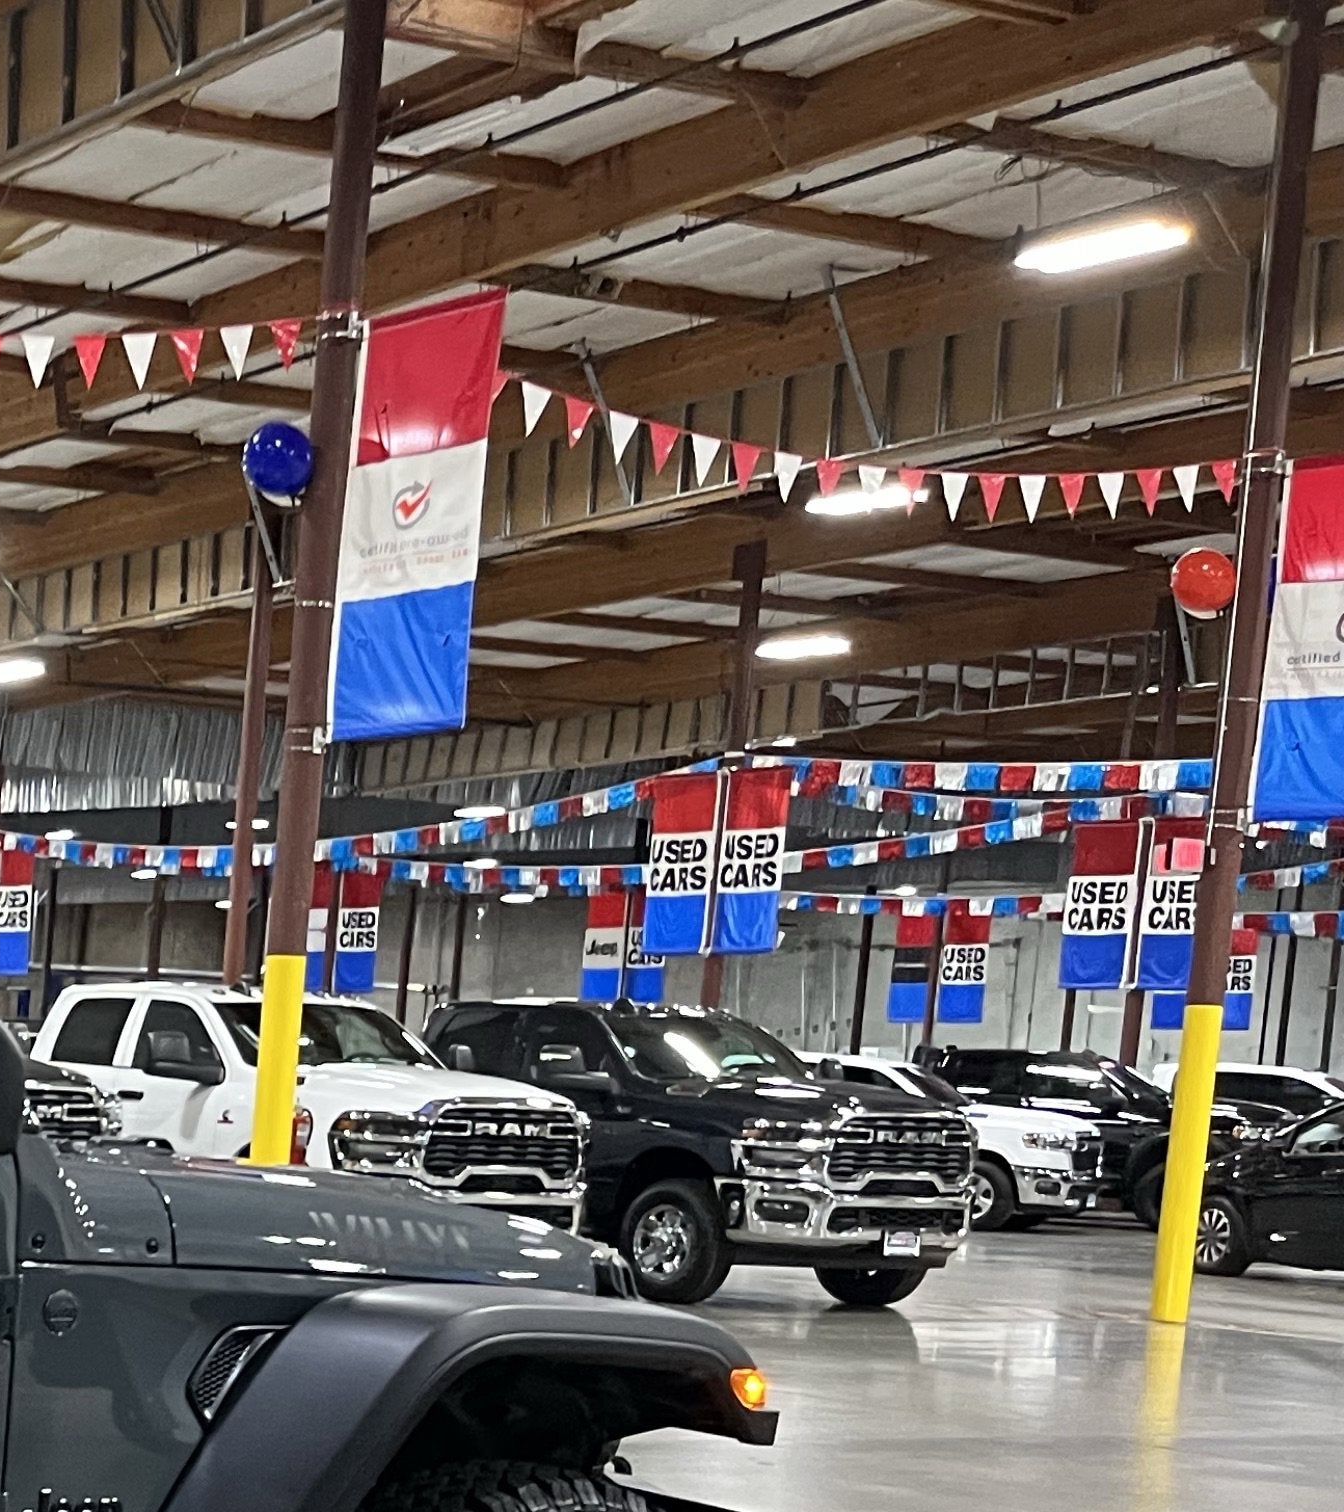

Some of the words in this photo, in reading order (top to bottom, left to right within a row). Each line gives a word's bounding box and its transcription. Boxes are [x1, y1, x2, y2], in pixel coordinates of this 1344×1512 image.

[652, 838, 708, 864] USED
[724, 833, 779, 860] USED
[650, 865, 707, 891] CARS
[720, 861, 777, 888] CARS
[1072, 881, 1128, 904] USED
[1152, 880, 1195, 903] USE
[342, 911, 376, 929] USED
[1068, 907, 1126, 930] CARS
[1148, 906, 1191, 930] CAR
[945, 947, 986, 964] USED
[942, 965, 985, 981] CARS
[474, 1122, 547, 1137] RAM
[876, 1130, 942, 1144] RAM
